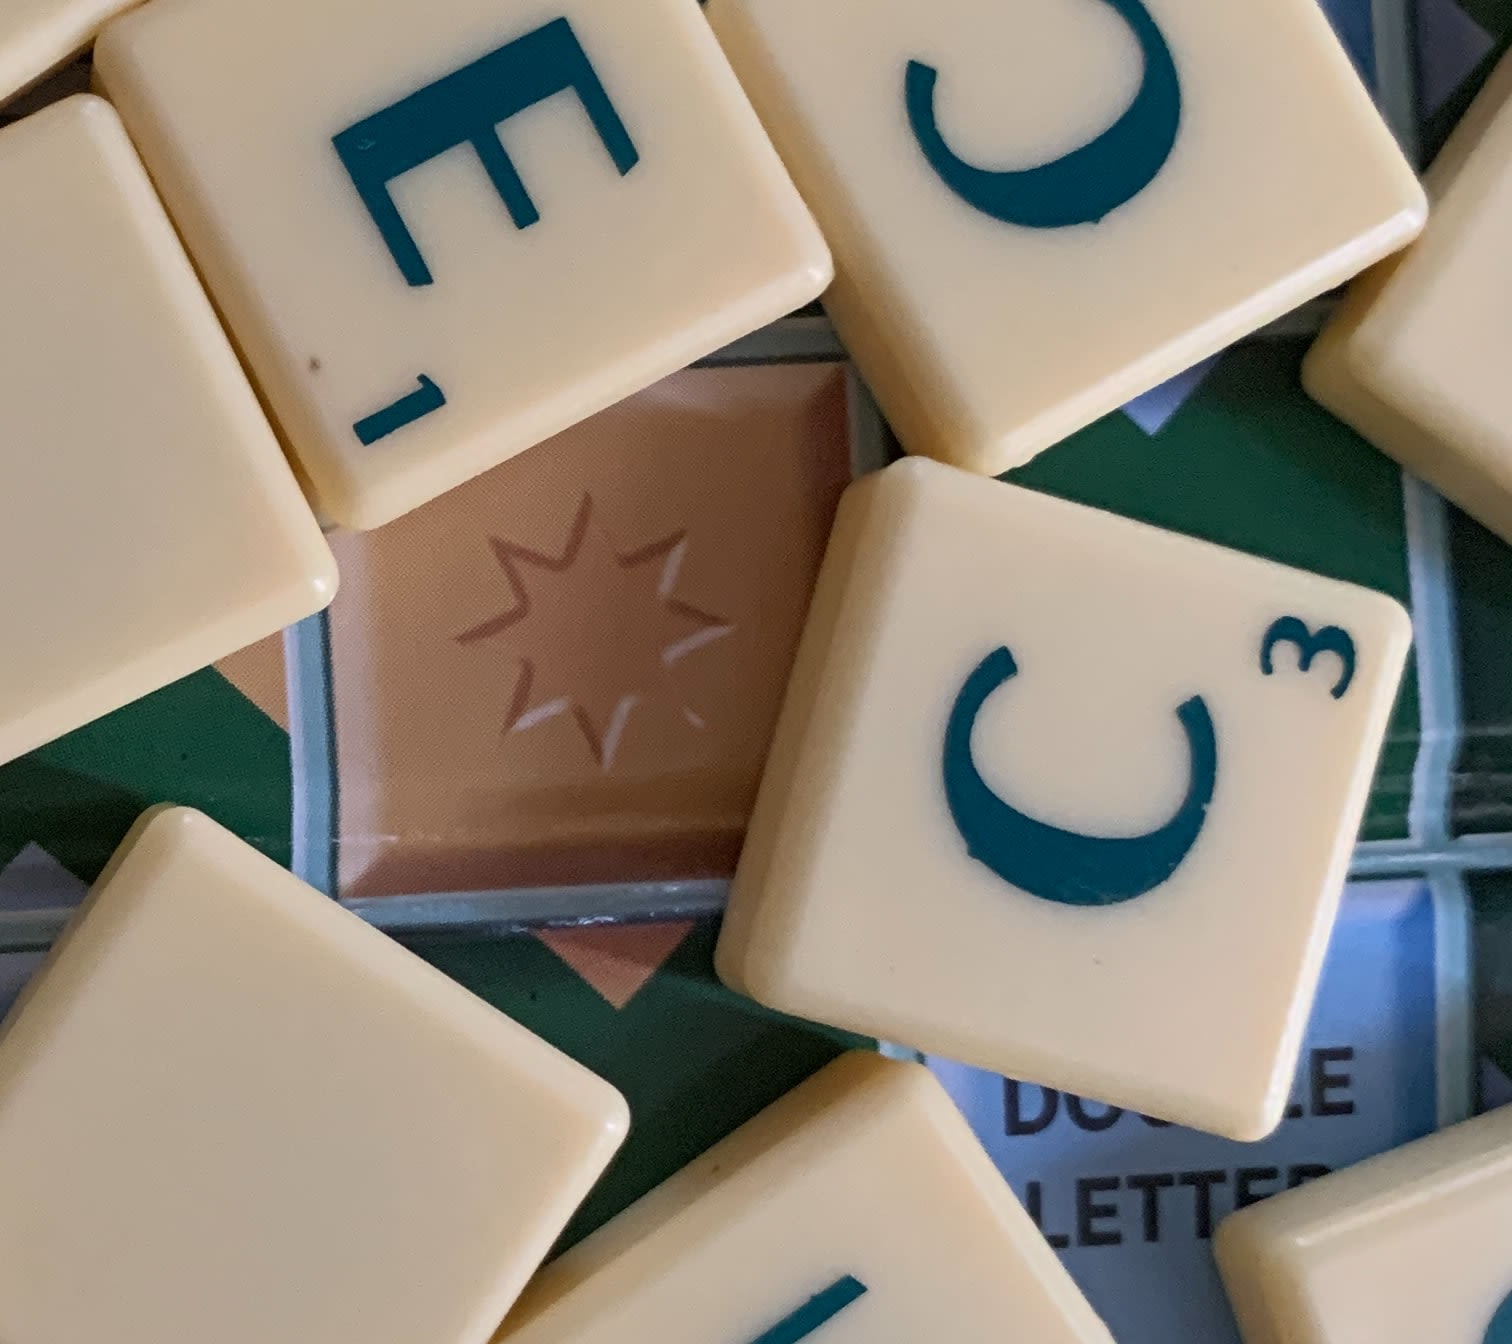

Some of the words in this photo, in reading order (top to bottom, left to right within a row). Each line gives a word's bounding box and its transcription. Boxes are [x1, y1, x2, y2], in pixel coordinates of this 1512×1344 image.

[332, 17, 638, 286] E
[355, 375, 445, 444] 1
[1262, 616, 1355, 697] 3
[943, 647, 1217, 906] C
[1024, 1163, 1333, 1249] LETTE
